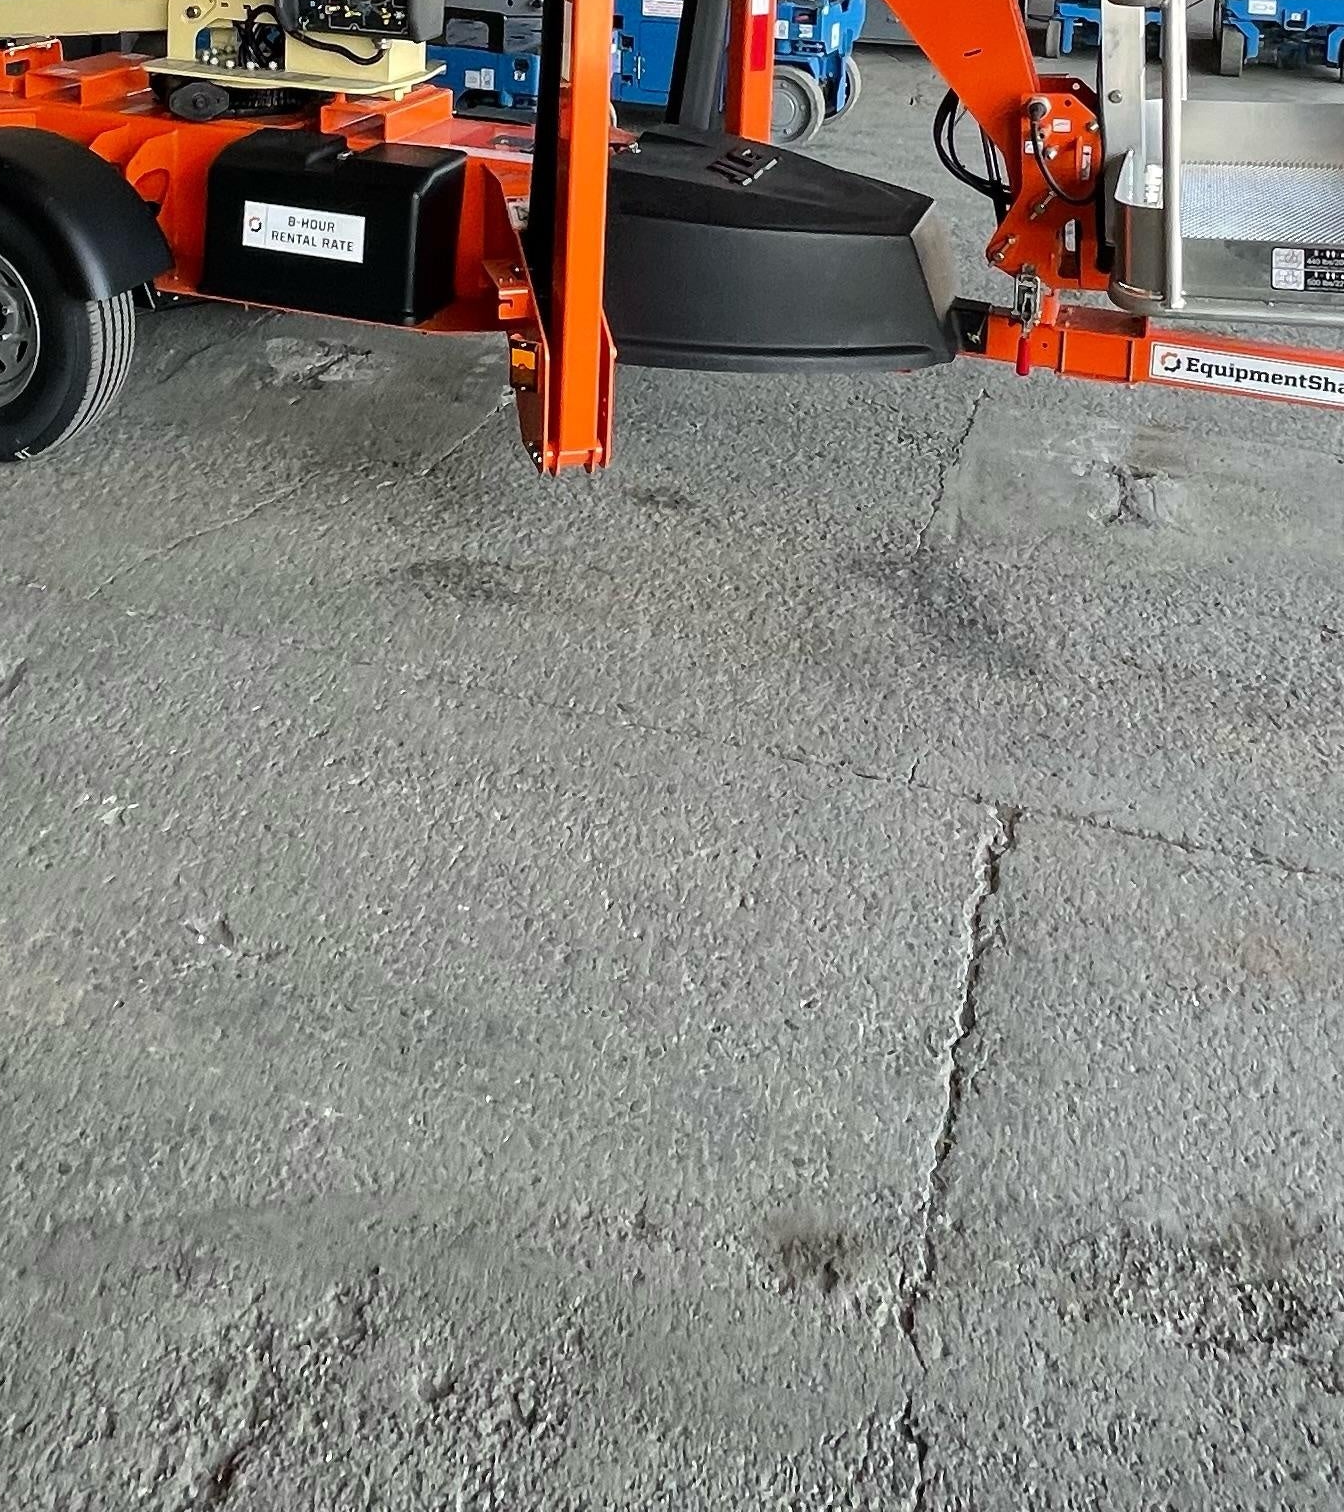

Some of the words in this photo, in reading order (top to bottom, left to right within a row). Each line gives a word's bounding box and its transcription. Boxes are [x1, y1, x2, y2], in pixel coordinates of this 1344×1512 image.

[287, 216, 335, 233] 8-HOUR
[271, 230, 318, 248] RENTAL
[322, 238, 354, 252] RATE
